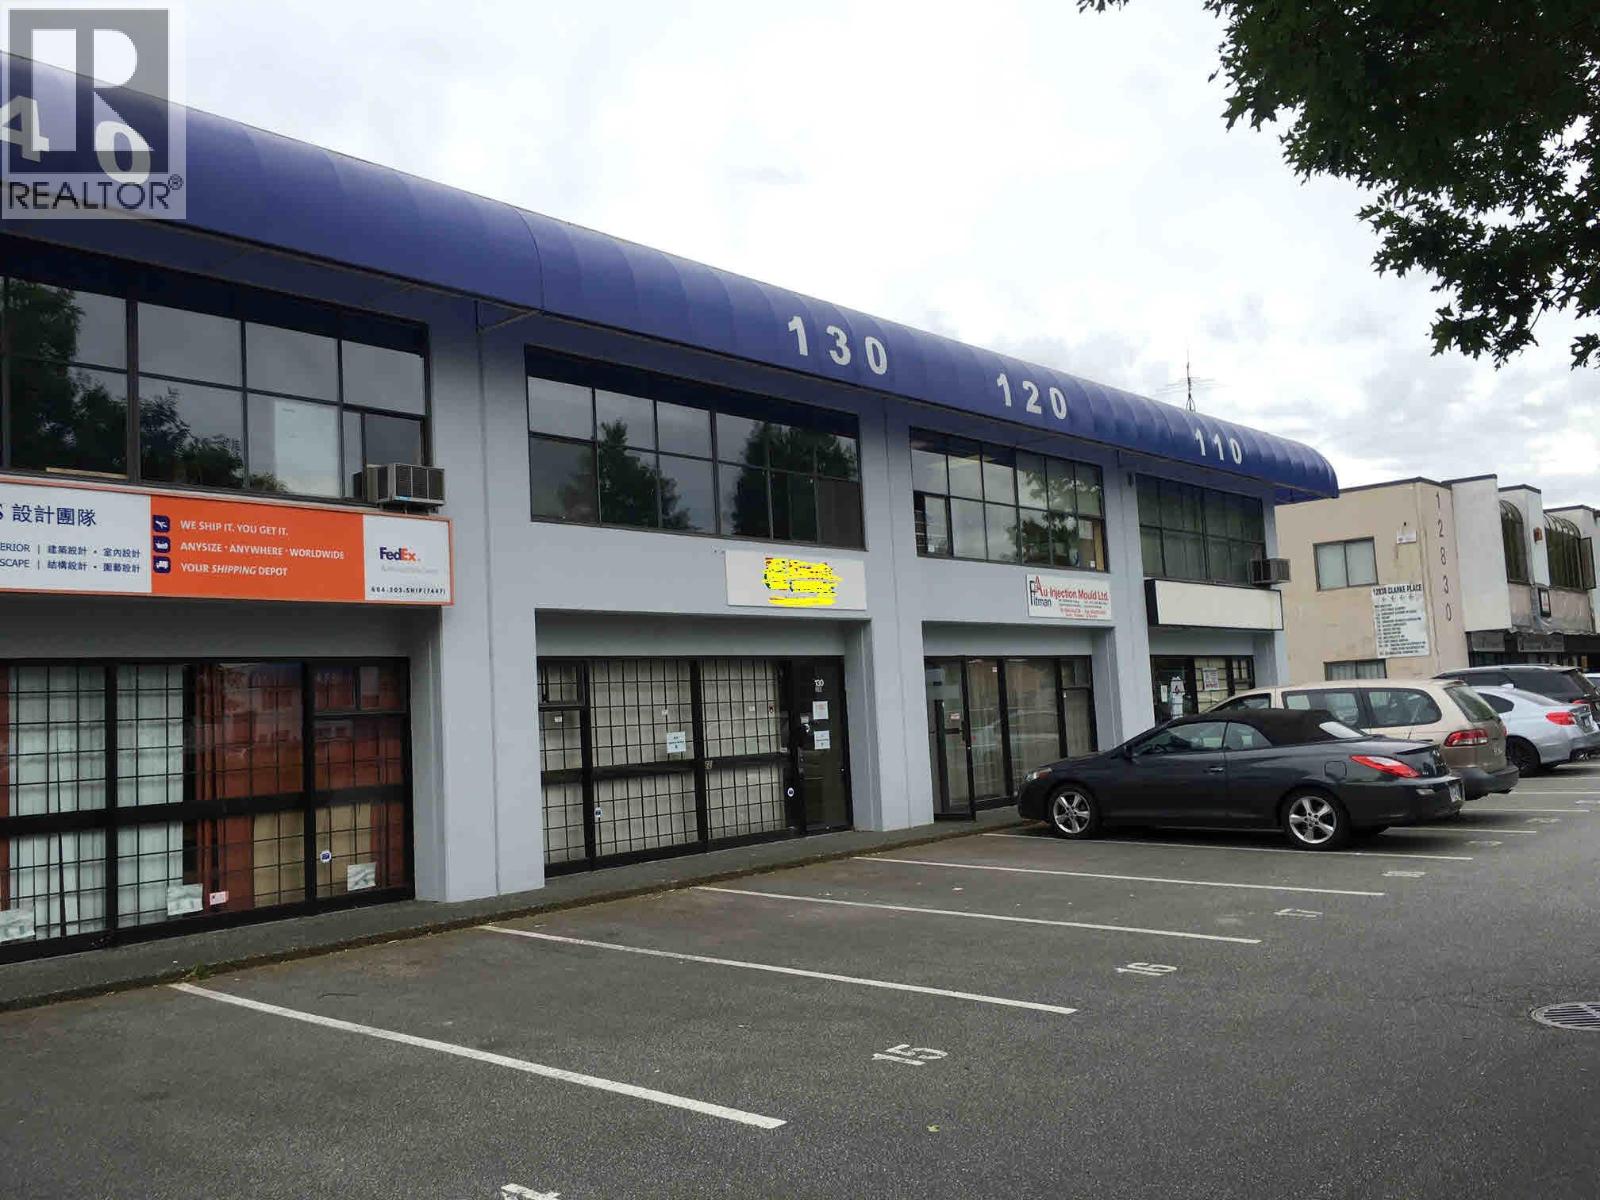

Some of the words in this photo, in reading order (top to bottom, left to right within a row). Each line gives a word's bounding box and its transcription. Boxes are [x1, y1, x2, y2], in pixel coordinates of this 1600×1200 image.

[788, 316, 888, 375] 130
[997, 373, 1067, 420] 120
[1195, 428, 1243, 464] 110
[12, 503, 97, 527] 設計團隊
[180, 520, 197, 530] WE
[199, 521, 222, 531] SHIP
[237, 524, 257, 534] YOU
[259, 525, 277, 535] GET
[180, 542, 222, 552] ANYSIZE
[229, 544, 283, 556] ANYWHERE
[289, 548, 345, 559] WORLDWIDE
[379, 546, 416, 562] FedEx
[1435, 491, 1453, 622] 12830
[181, 563, 209, 573] YOUR
[211, 564, 257, 575] SHIPPING
[258, 566, 289, 576] DEPOT
[1050, 587, 1078, 600] Injection
[1078, 589, 1097, 600] Mould
[872, 1044, 949, 1066] 15
